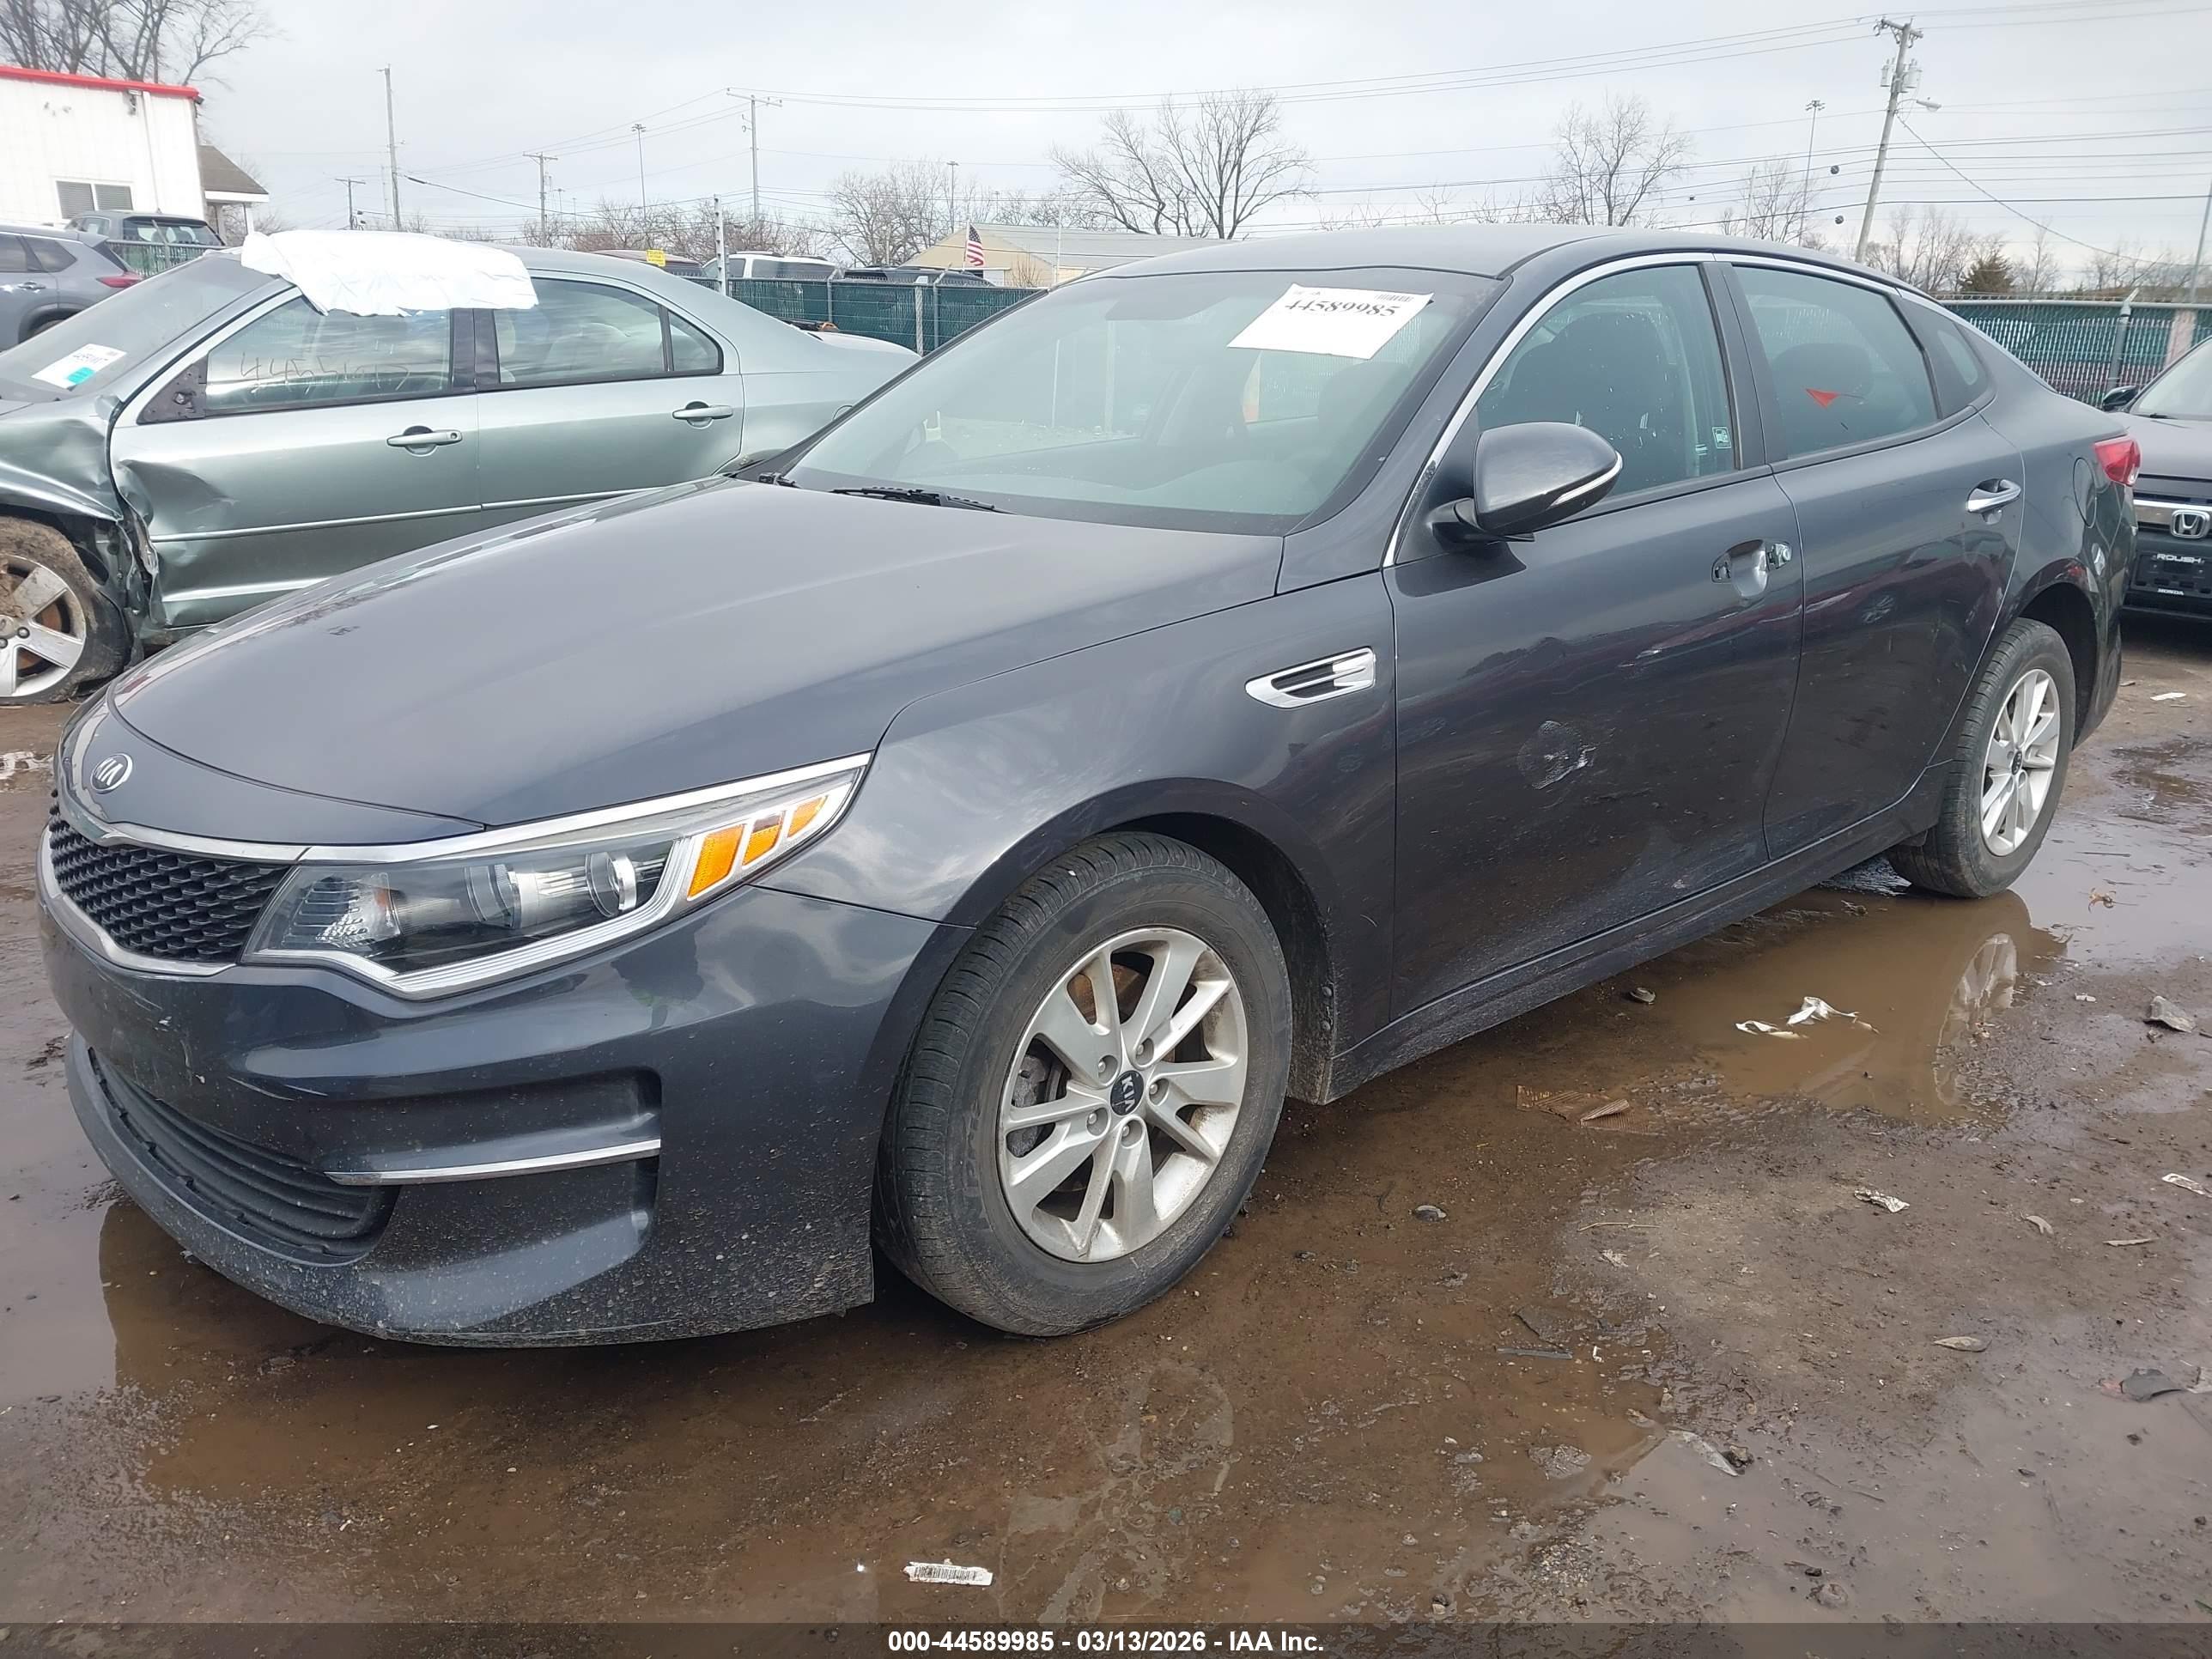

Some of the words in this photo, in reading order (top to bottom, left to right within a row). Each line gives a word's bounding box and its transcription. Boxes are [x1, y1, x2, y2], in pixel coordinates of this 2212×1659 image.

[1285, 300, 1401, 317] 44589985
[2156, 553, 2202, 564] ROUSH
[1121, 1073, 1135, 1113] KIA
